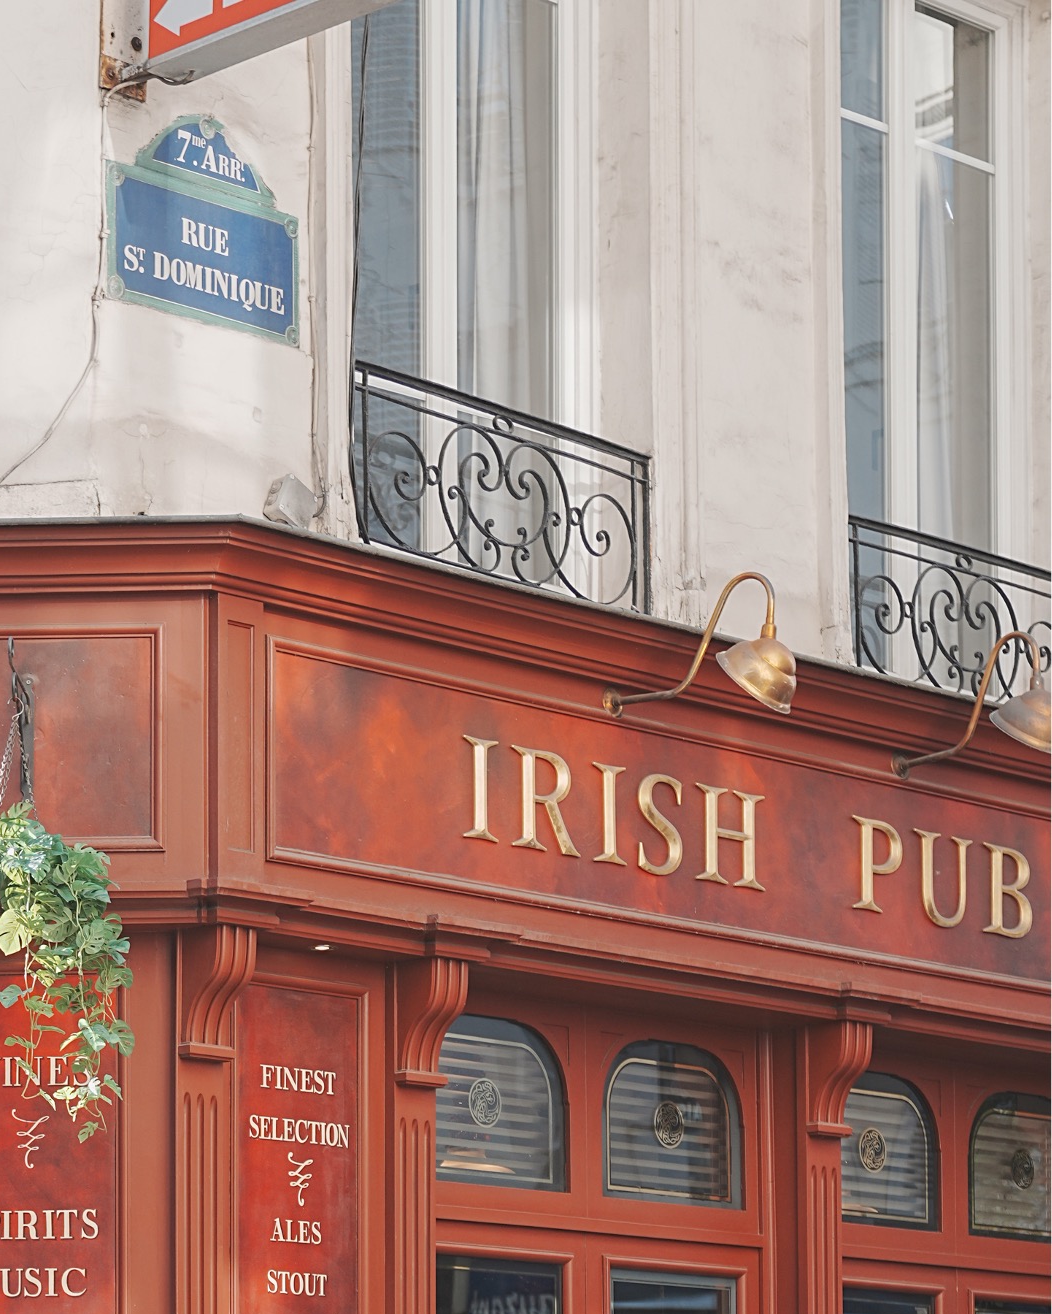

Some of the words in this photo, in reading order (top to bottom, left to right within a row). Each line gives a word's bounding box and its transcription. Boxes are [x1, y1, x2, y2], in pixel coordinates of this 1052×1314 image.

[181, 217, 229, 257] RUE
[153, 251, 285, 316] DOMINIQUE
[462, 734, 766, 892] IRISH
[851, 814, 1034, 939] PUB
[260, 1063, 337, 1096] FINEST
[249, 1114, 350, 1149] SELECTION
[270, 1217, 322, 1245] ALES
[267, 1269, 327, 1297] STOUT
